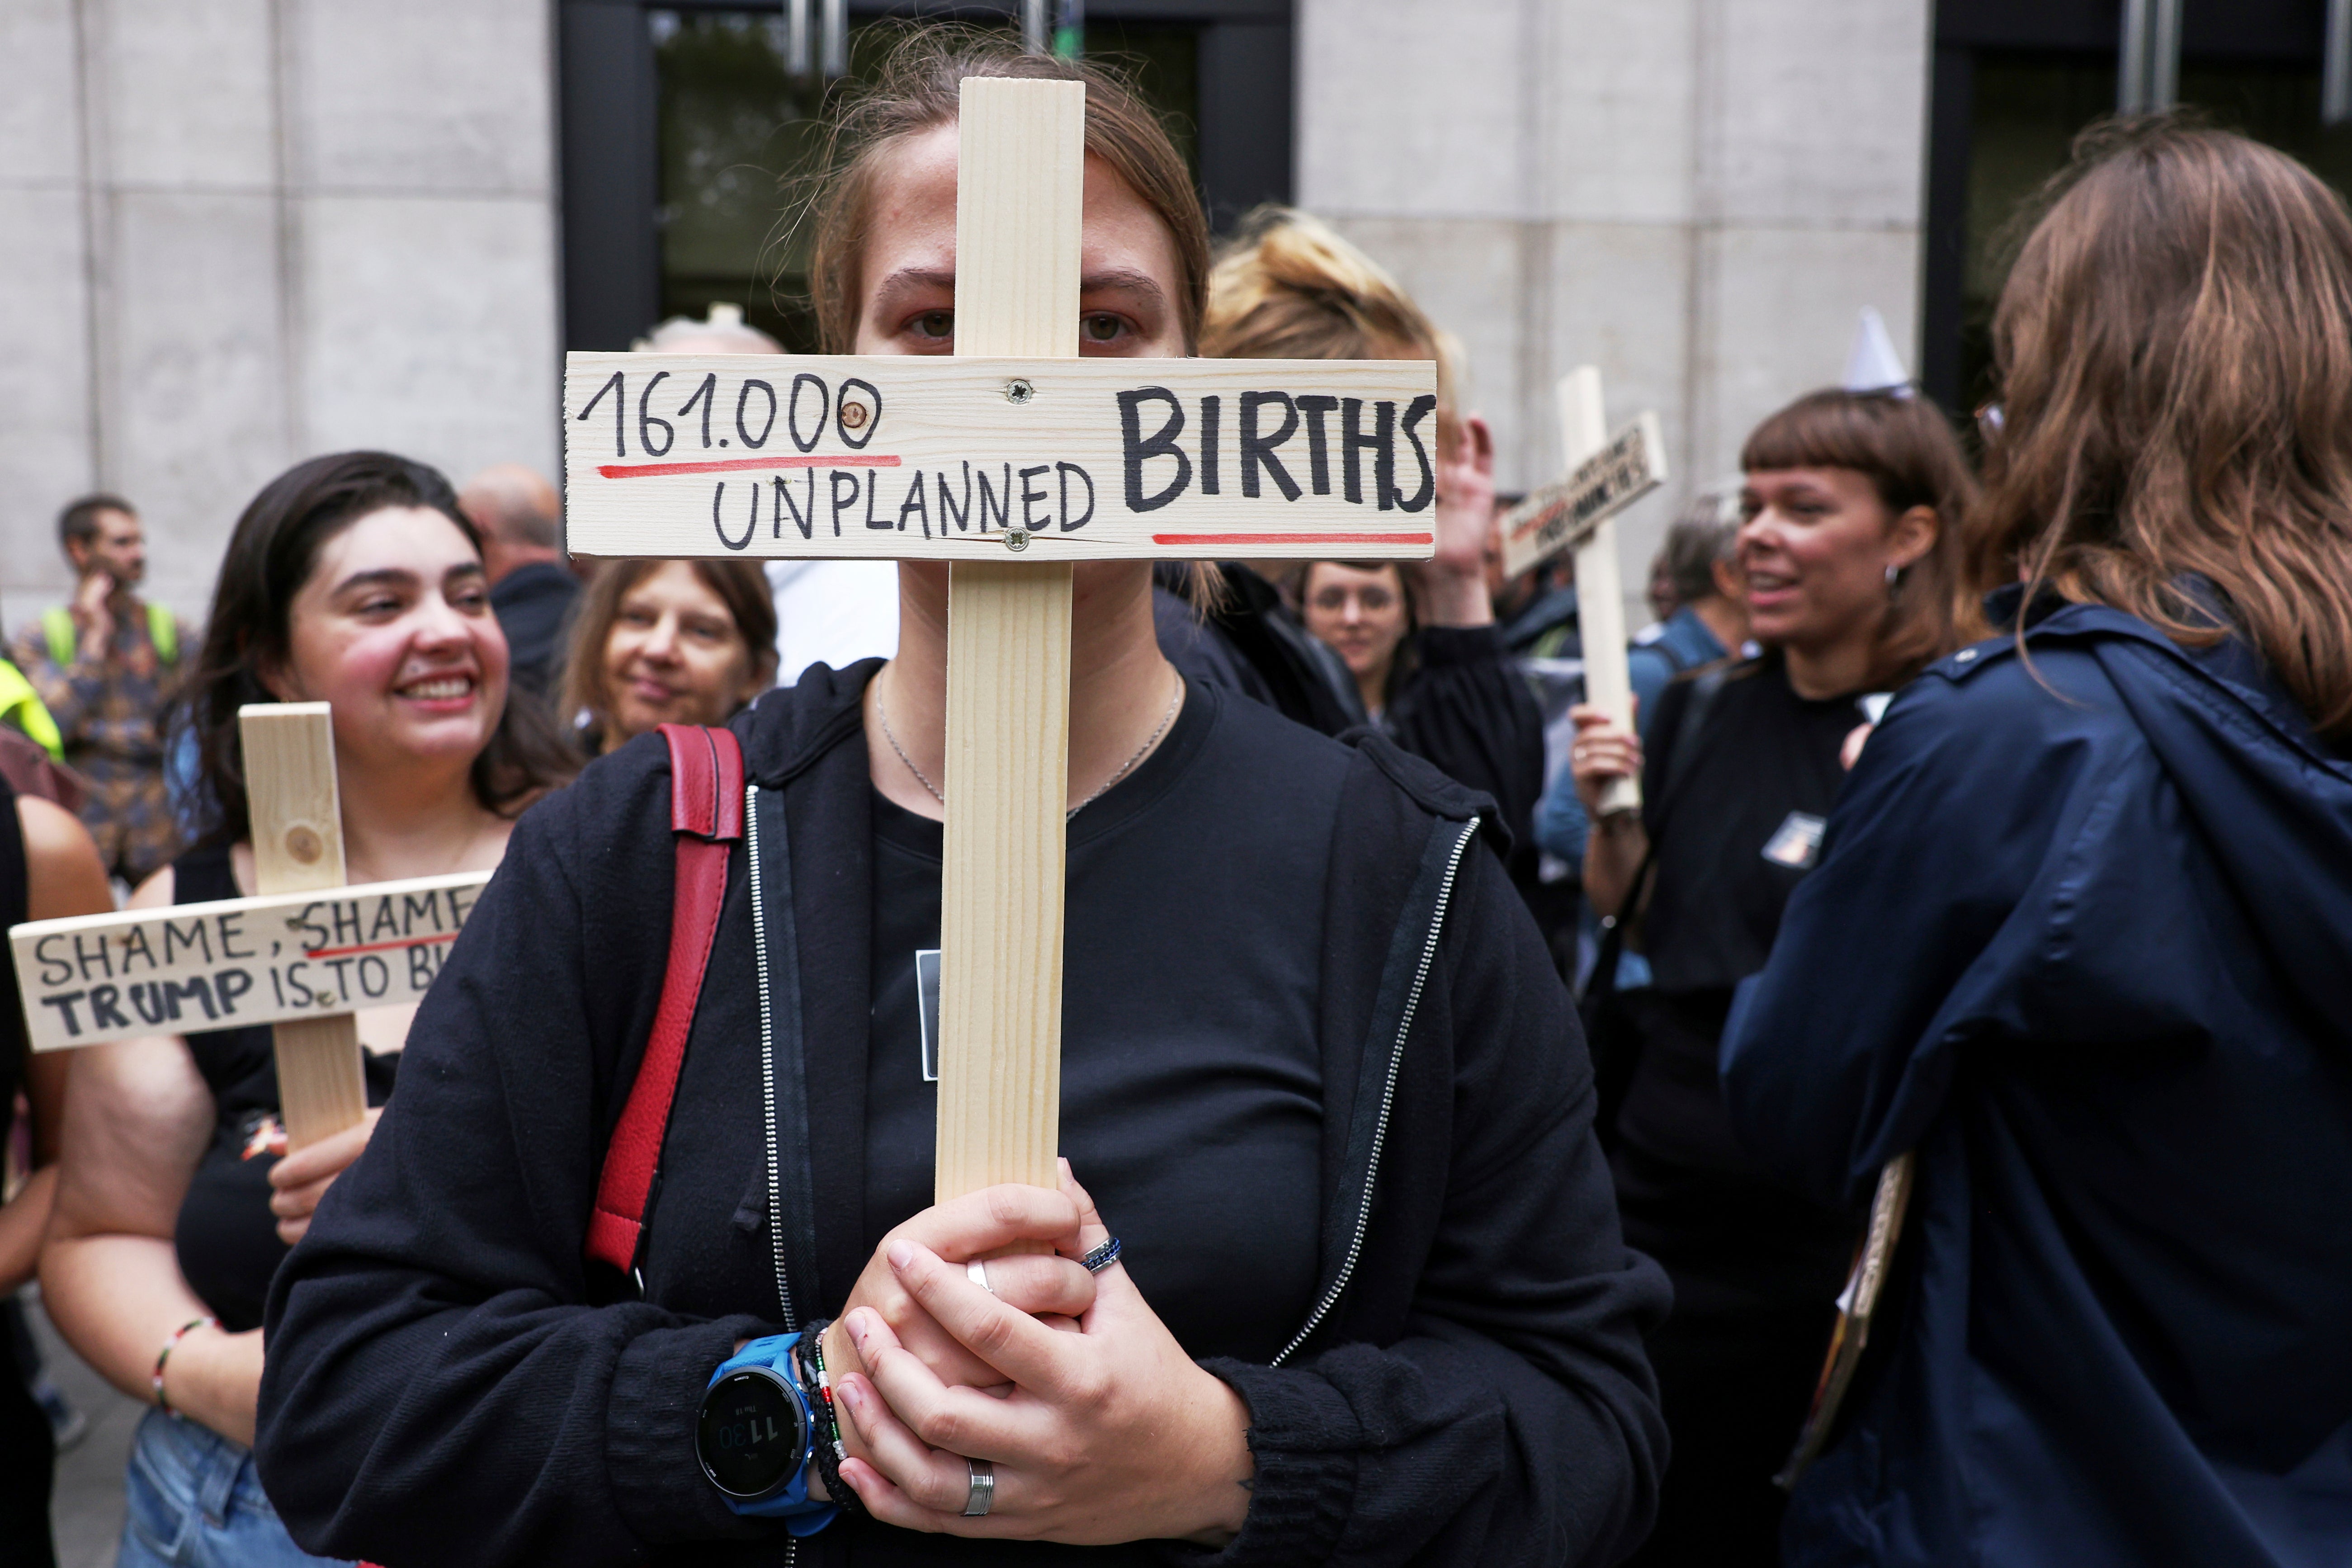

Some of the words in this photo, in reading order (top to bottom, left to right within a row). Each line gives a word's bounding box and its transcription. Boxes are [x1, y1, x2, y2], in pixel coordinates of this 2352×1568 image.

[577, 370, 882, 457] 161.000
[713, 460, 1095, 550] UNPLANNED
[1116, 386, 1436, 513] BIRTHS
[41, 968, 253, 1036] TRUMP
[271, 961, 315, 1008] IS
[324, 955, 389, 1002] TO
